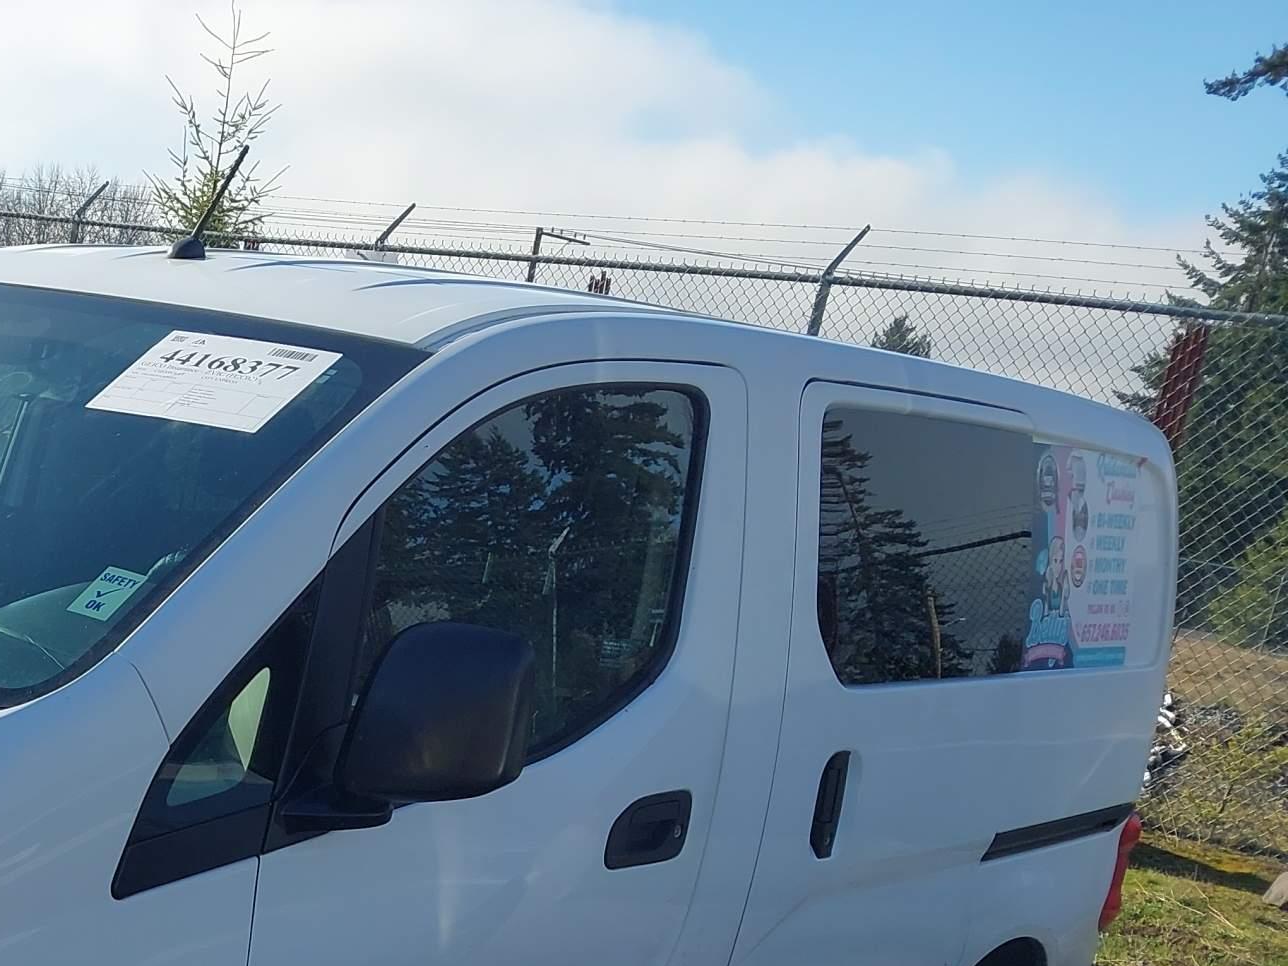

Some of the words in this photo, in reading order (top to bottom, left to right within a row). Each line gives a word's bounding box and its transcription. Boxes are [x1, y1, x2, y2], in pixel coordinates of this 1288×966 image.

[160, 349, 301, 380] 44168377
[1095, 535, 1126, 551] WEEKLY
[100, 572, 142, 589] SAFETY
[84, 599, 106, 612] OK
